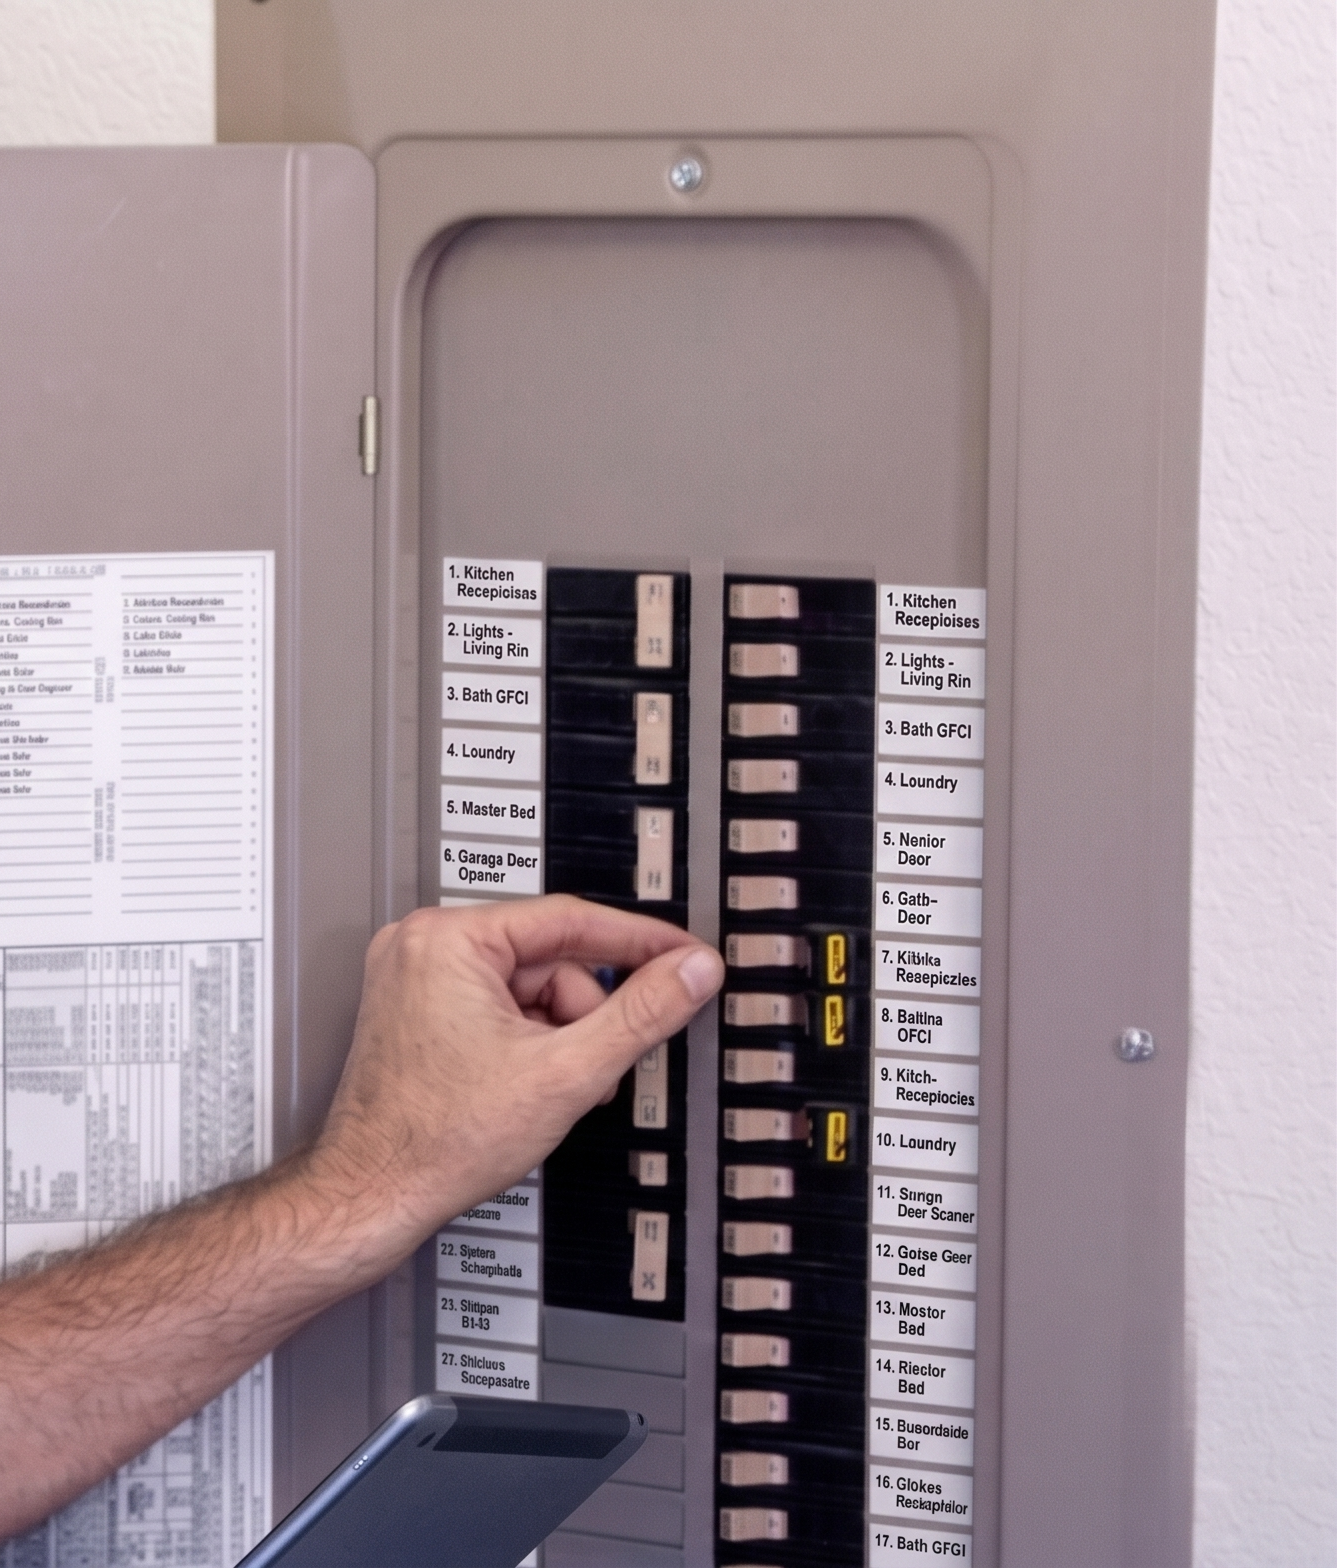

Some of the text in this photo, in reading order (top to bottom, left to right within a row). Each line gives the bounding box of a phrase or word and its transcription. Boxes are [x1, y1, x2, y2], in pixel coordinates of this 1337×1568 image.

[449, 565, 514, 581] 1. Kitchen
[457, 583, 537, 601] Recepicisas
[887, 592, 956, 609] 1. Kitchen
[895, 611, 980, 630] Recepioises
[448, 622, 459, 637] 2.
[463, 623, 504, 641] Lights
[463, 640, 529, 660] Living Rin
[885, 652, 897, 666] 2.
[901, 652, 945, 671] Lights
[901, 671, 971, 691] Living Rin
[447, 687, 529, 705] 3. Bath GFCI
[885, 720, 972, 740] 3. Bath GFCI
[447, 743, 459, 757] 4.
[884, 772, 897, 787] 4.
[446, 800, 536, 819] 5. Master Bed
[883, 831, 946, 849] 5. Nenior
[444, 848, 455, 862] 6.
[458, 849, 503, 869] Garaga
[458, 867, 506, 884] Opaner
[882, 891, 894, 905] 6.
[898, 909, 932, 925] Deor
[882, 950, 894, 964] 7.
[881, 1007, 893, 1023] 8.
[897, 1027, 932, 1044] OFCI
[880, 1067, 937, 1084] 9. Kitch-
[876, 1133, 896, 1147] 10.
[877, 1185, 895, 1200] 11.
[897, 1203, 975, 1224] Deer Scaner
[440, 1242, 457, 1257] 22.
[875, 1243, 894, 1258] 12.
[941, 1249, 973, 1265] Geer
[898, 1263, 926, 1278] Ded
[441, 1297, 458, 1312] 23.
[875, 1300, 946, 1320] 13. Mostor
[441, 1352, 458, 1367] 27.
[876, 1358, 895, 1374] 14.
[875, 1417, 894, 1432] 15.
[875, 1474, 942, 1495] 16. Glokes
[875, 1534, 893, 1548] 17.
[897, 1536, 928, 1553] Bath
